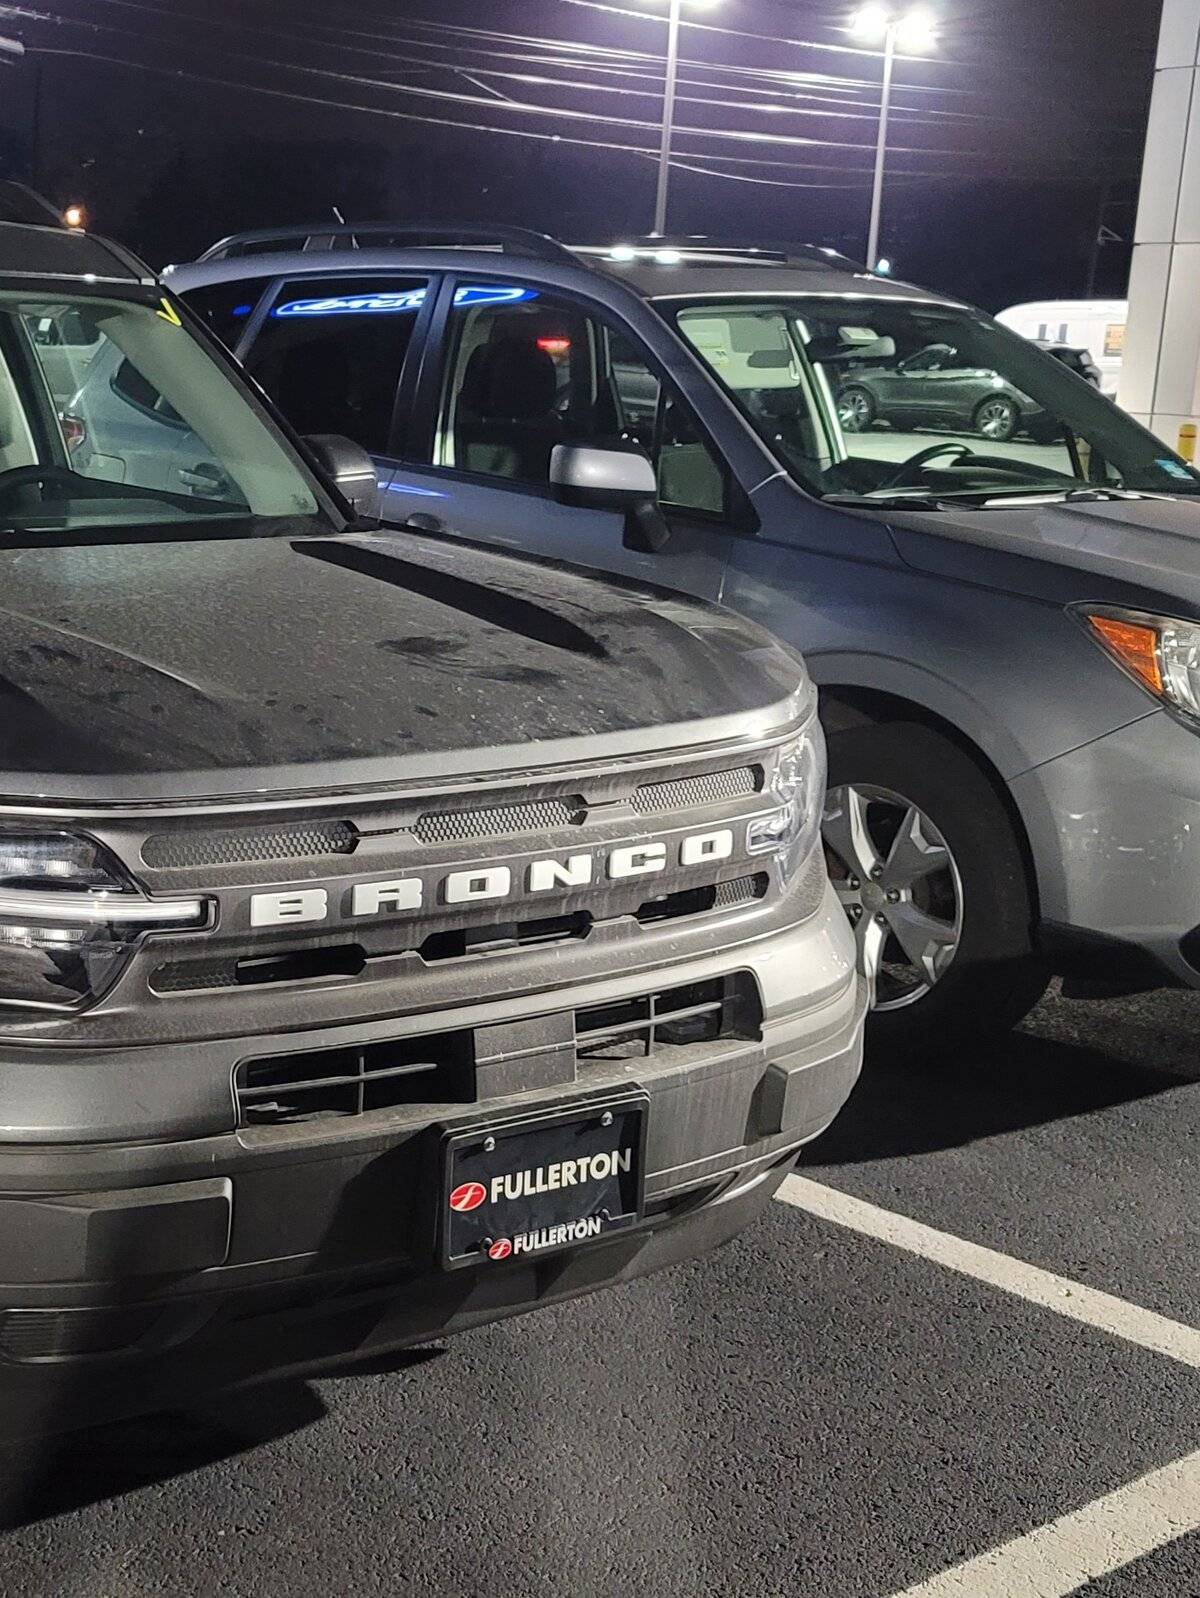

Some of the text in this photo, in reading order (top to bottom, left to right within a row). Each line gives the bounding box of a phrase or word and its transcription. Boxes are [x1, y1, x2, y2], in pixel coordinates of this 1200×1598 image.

[250, 829, 734, 927] BRONCO
[490, 1147, 632, 1204] FULLERTON
[513, 1217, 601, 1255] FULLERTON
